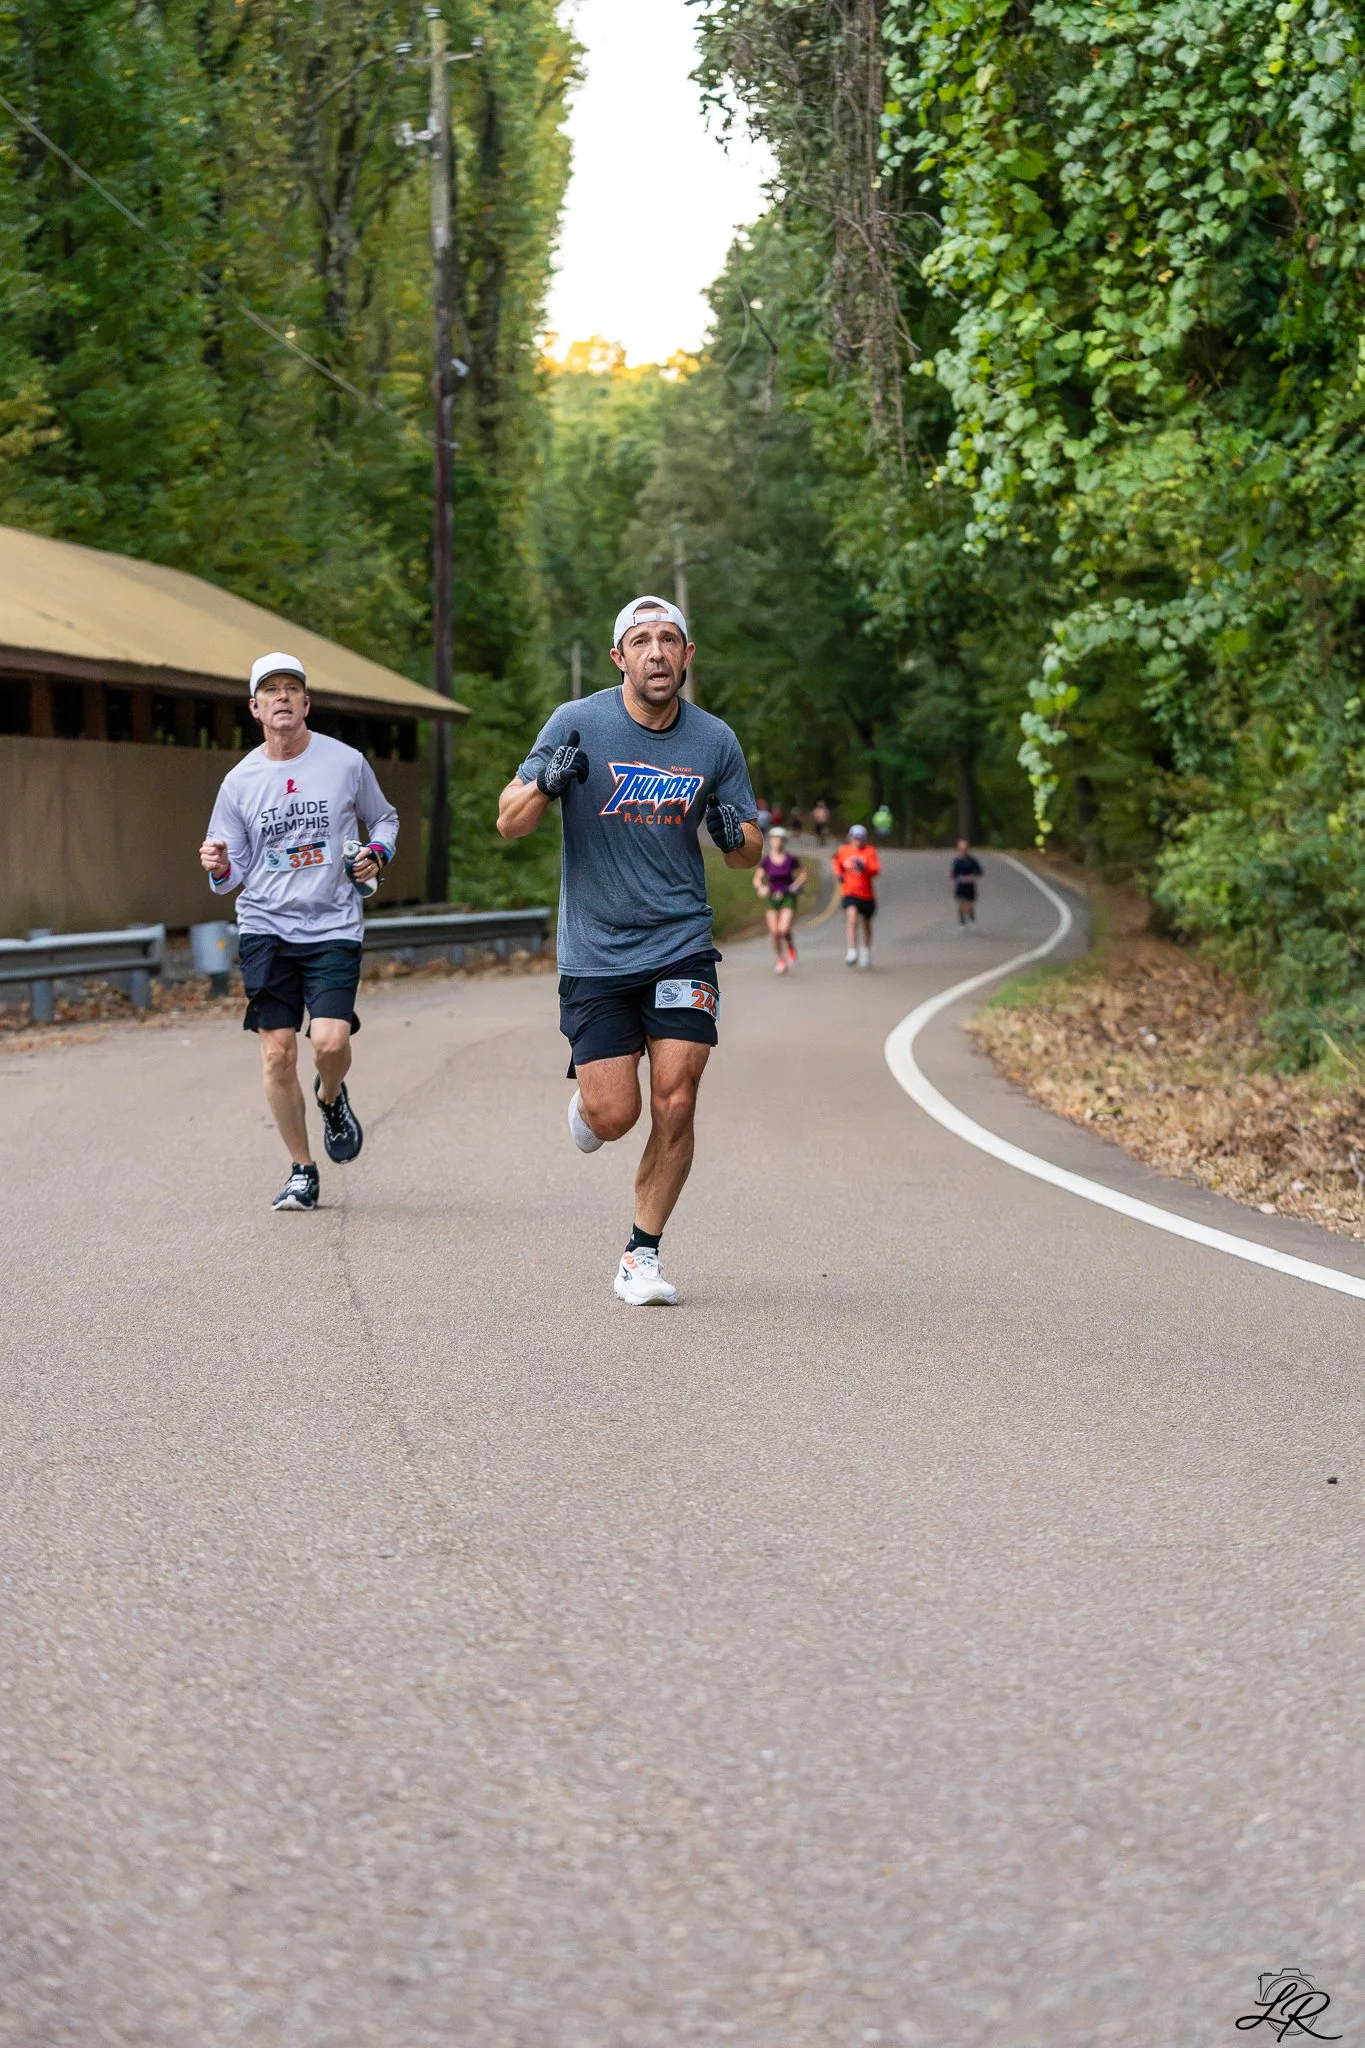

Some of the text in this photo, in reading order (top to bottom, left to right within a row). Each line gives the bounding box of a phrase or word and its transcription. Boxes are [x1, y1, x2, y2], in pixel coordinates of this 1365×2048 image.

[599, 761, 704, 816] THUNDER
[261, 800, 328, 823] ST. JUDE
[624, 812, 682, 825] RACING
[262, 816, 330, 837] MEMPHIS
[289, 848, 324, 868] 325
[691, 990, 718, 1017] 246
